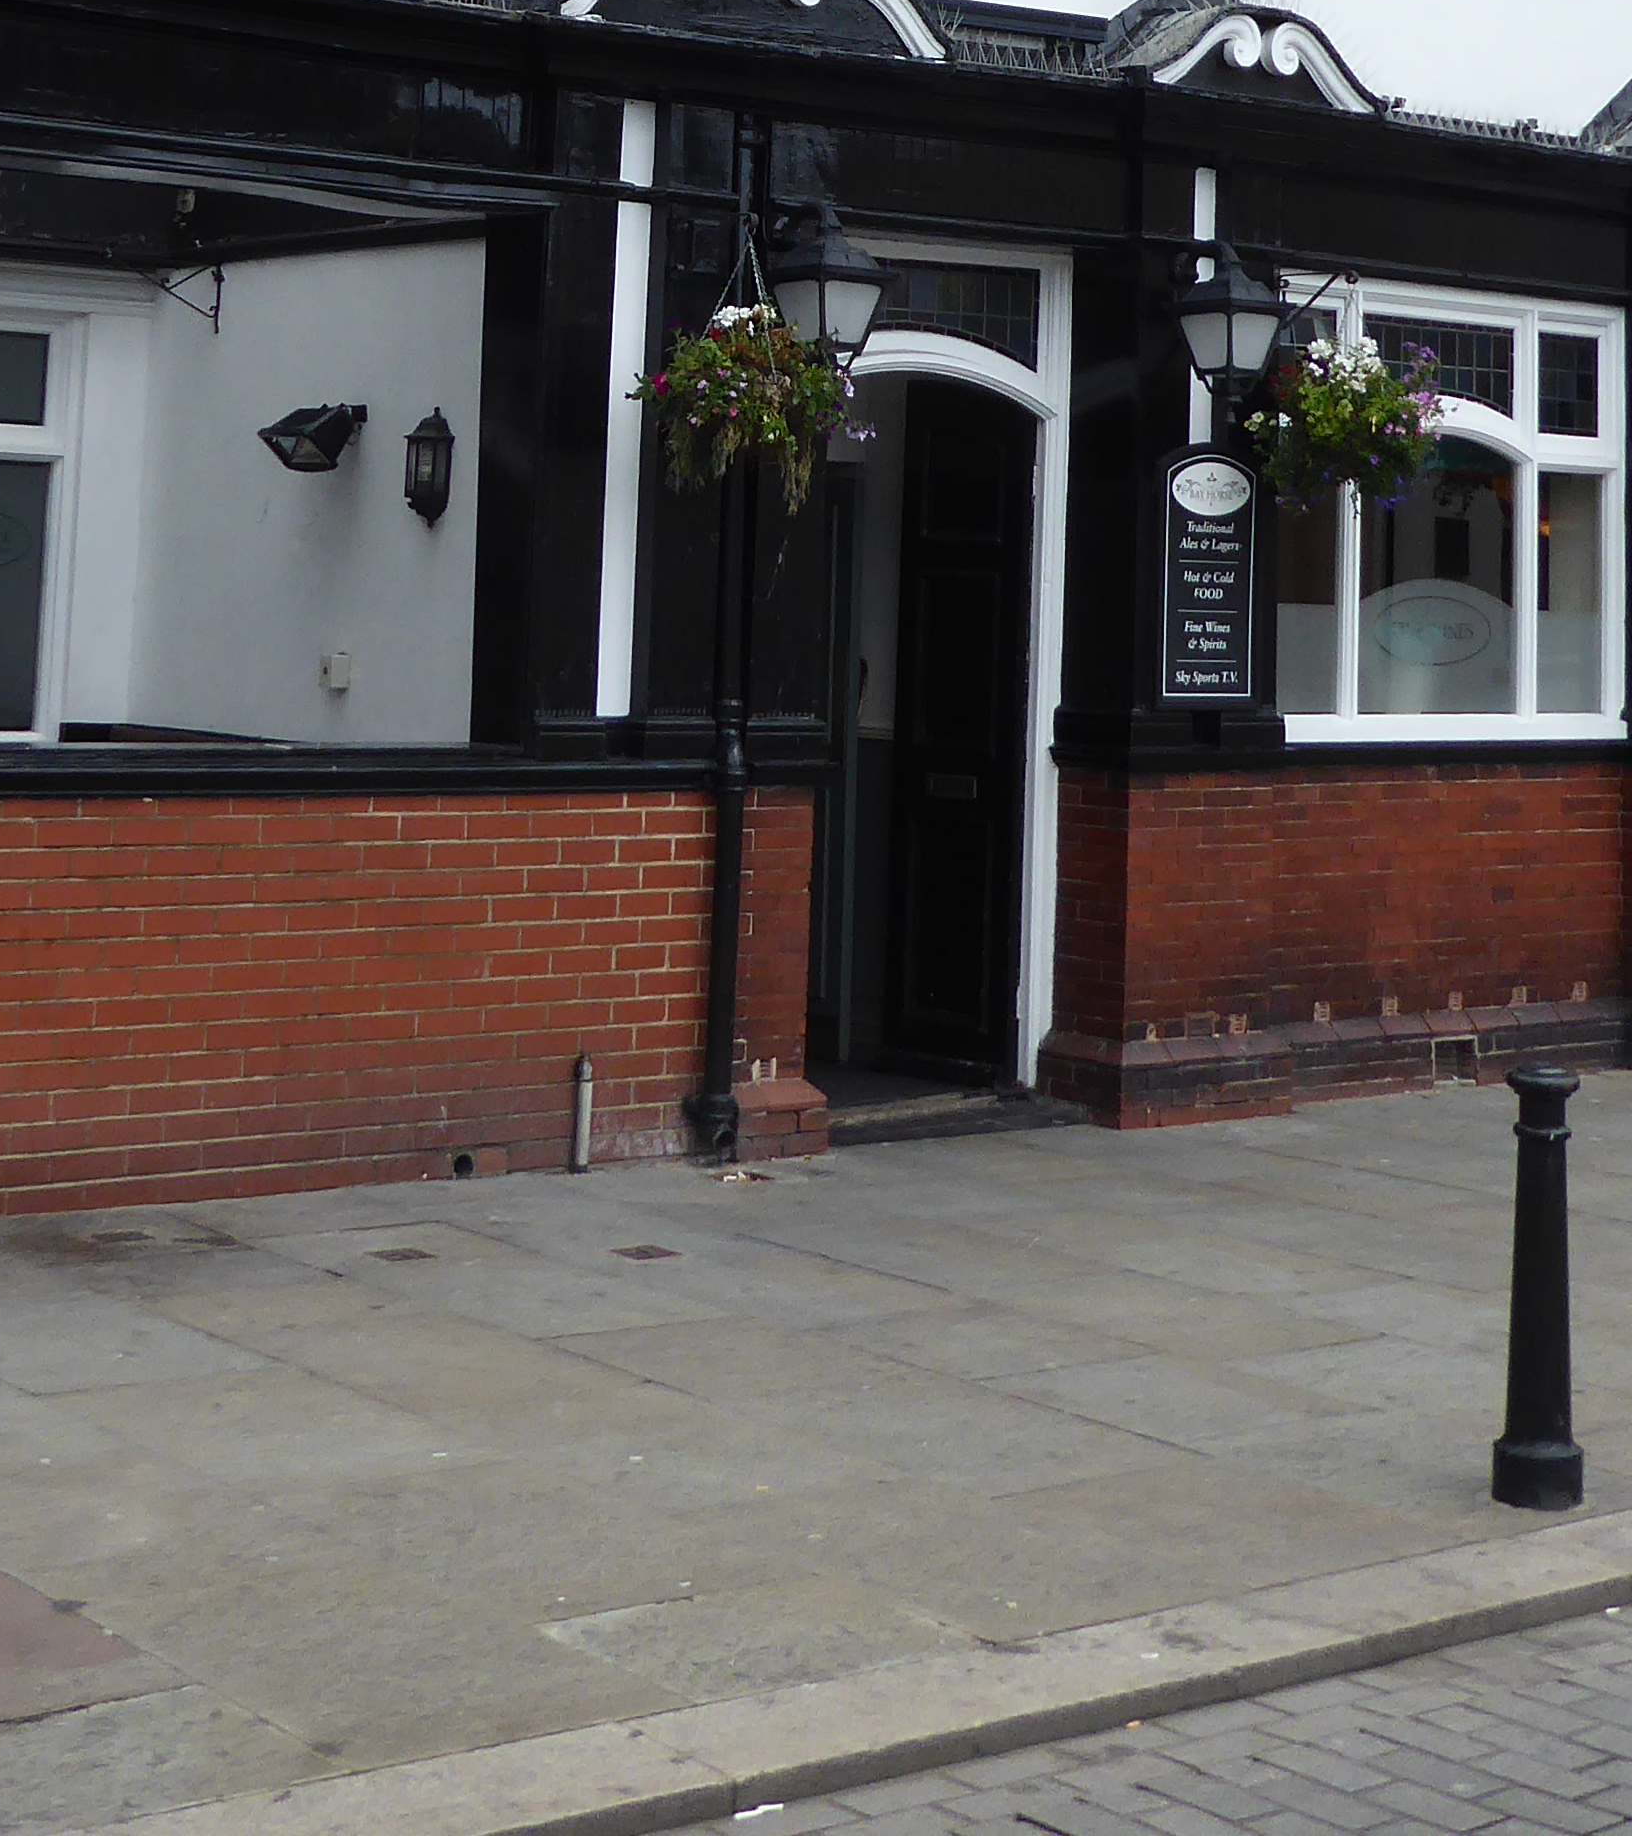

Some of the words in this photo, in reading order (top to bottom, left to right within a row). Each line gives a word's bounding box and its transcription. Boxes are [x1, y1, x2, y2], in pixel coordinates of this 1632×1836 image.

[1187, 520, 1235, 534] Traditional
[1179, 536, 1199, 549] Ales
[1200, 538, 1210, 550] &
[1184, 570, 1200, 582] Hot
[1202, 570, 1212, 583] &
[1213, 570, 1235, 583] Cold
[1194, 587, 1224, 600] FOOD
[1184, 620, 1203, 632] Fine
[1205, 620, 1231, 633] Wines
[1188, 637, 1198, 649] &
[1198, 637, 1227, 652] Spirits
[1175, 670, 1191, 685] Sky
[1192, 670, 1219, 685] Sports
